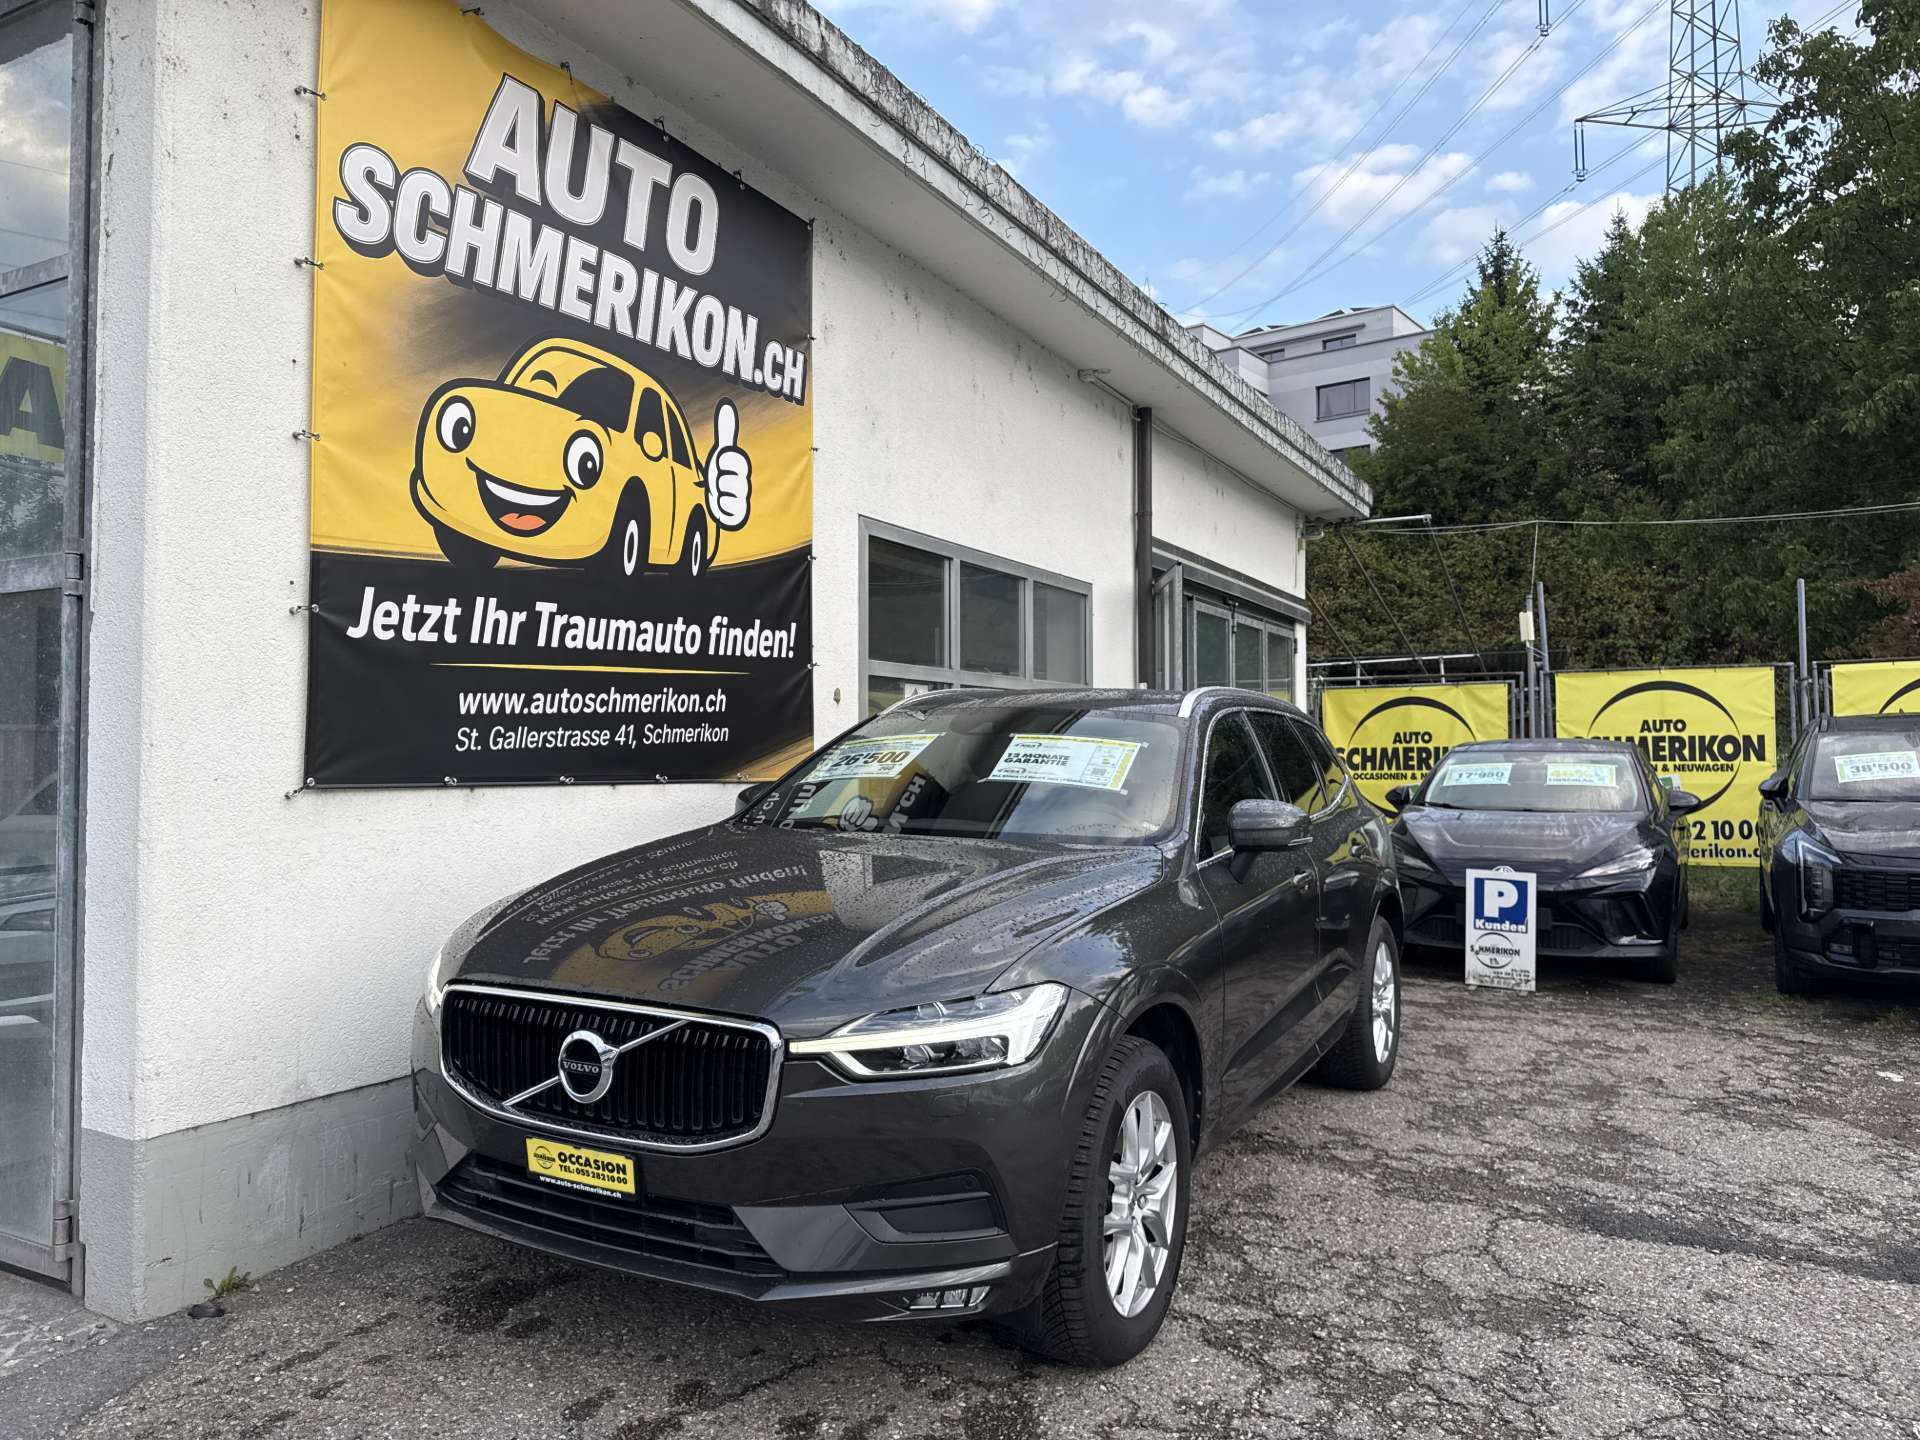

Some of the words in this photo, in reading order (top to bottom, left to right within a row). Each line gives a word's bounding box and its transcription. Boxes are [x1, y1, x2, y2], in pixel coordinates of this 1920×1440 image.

[465, 74, 720, 276] AUTO
[335, 144, 806, 401] SCHMERIKON.CH
[346, 586, 461, 643] Jetzt
[469, 597, 527, 647] Ihr
[535, 602, 702, 655] Traumauto
[709, 615, 797, 659] finden!
[458, 686, 727, 715] www.autoschmerikon.ch
[1640, 719, 1687, 733] AUTO
[455, 727, 482, 752] St.
[489, 724, 611, 751] Gallerstrasse
[614, 724, 637, 747] 41,
[642, 723, 730, 745] Schmerikon
[1392, 732, 1433, 744] AUTO
[1574, 735, 1766, 762] MERIKON
[831, 751, 910, 767] 26'500
[1004, 757, 1070, 766] GARANTIE
[1022, 752, 1072, 761] MONATE
[1661, 763, 1670, 772] &
[1674, 763, 1734, 772] NEUWAGEN
[1850, 762, 1912, 773] 38'500
[1353, 772, 1408, 780] OCCASIONEN
[1711, 820, 1734, 840] 10
[1739, 820, 1760, 840] 0
[1483, 879, 1519, 918] P
[1475, 918, 1527, 933] Kunden
[563, 1061, 599, 1074] VOLVO
[558, 1151, 627, 1175] OCCASION
[559, 1163, 575, 1174] TEL:
